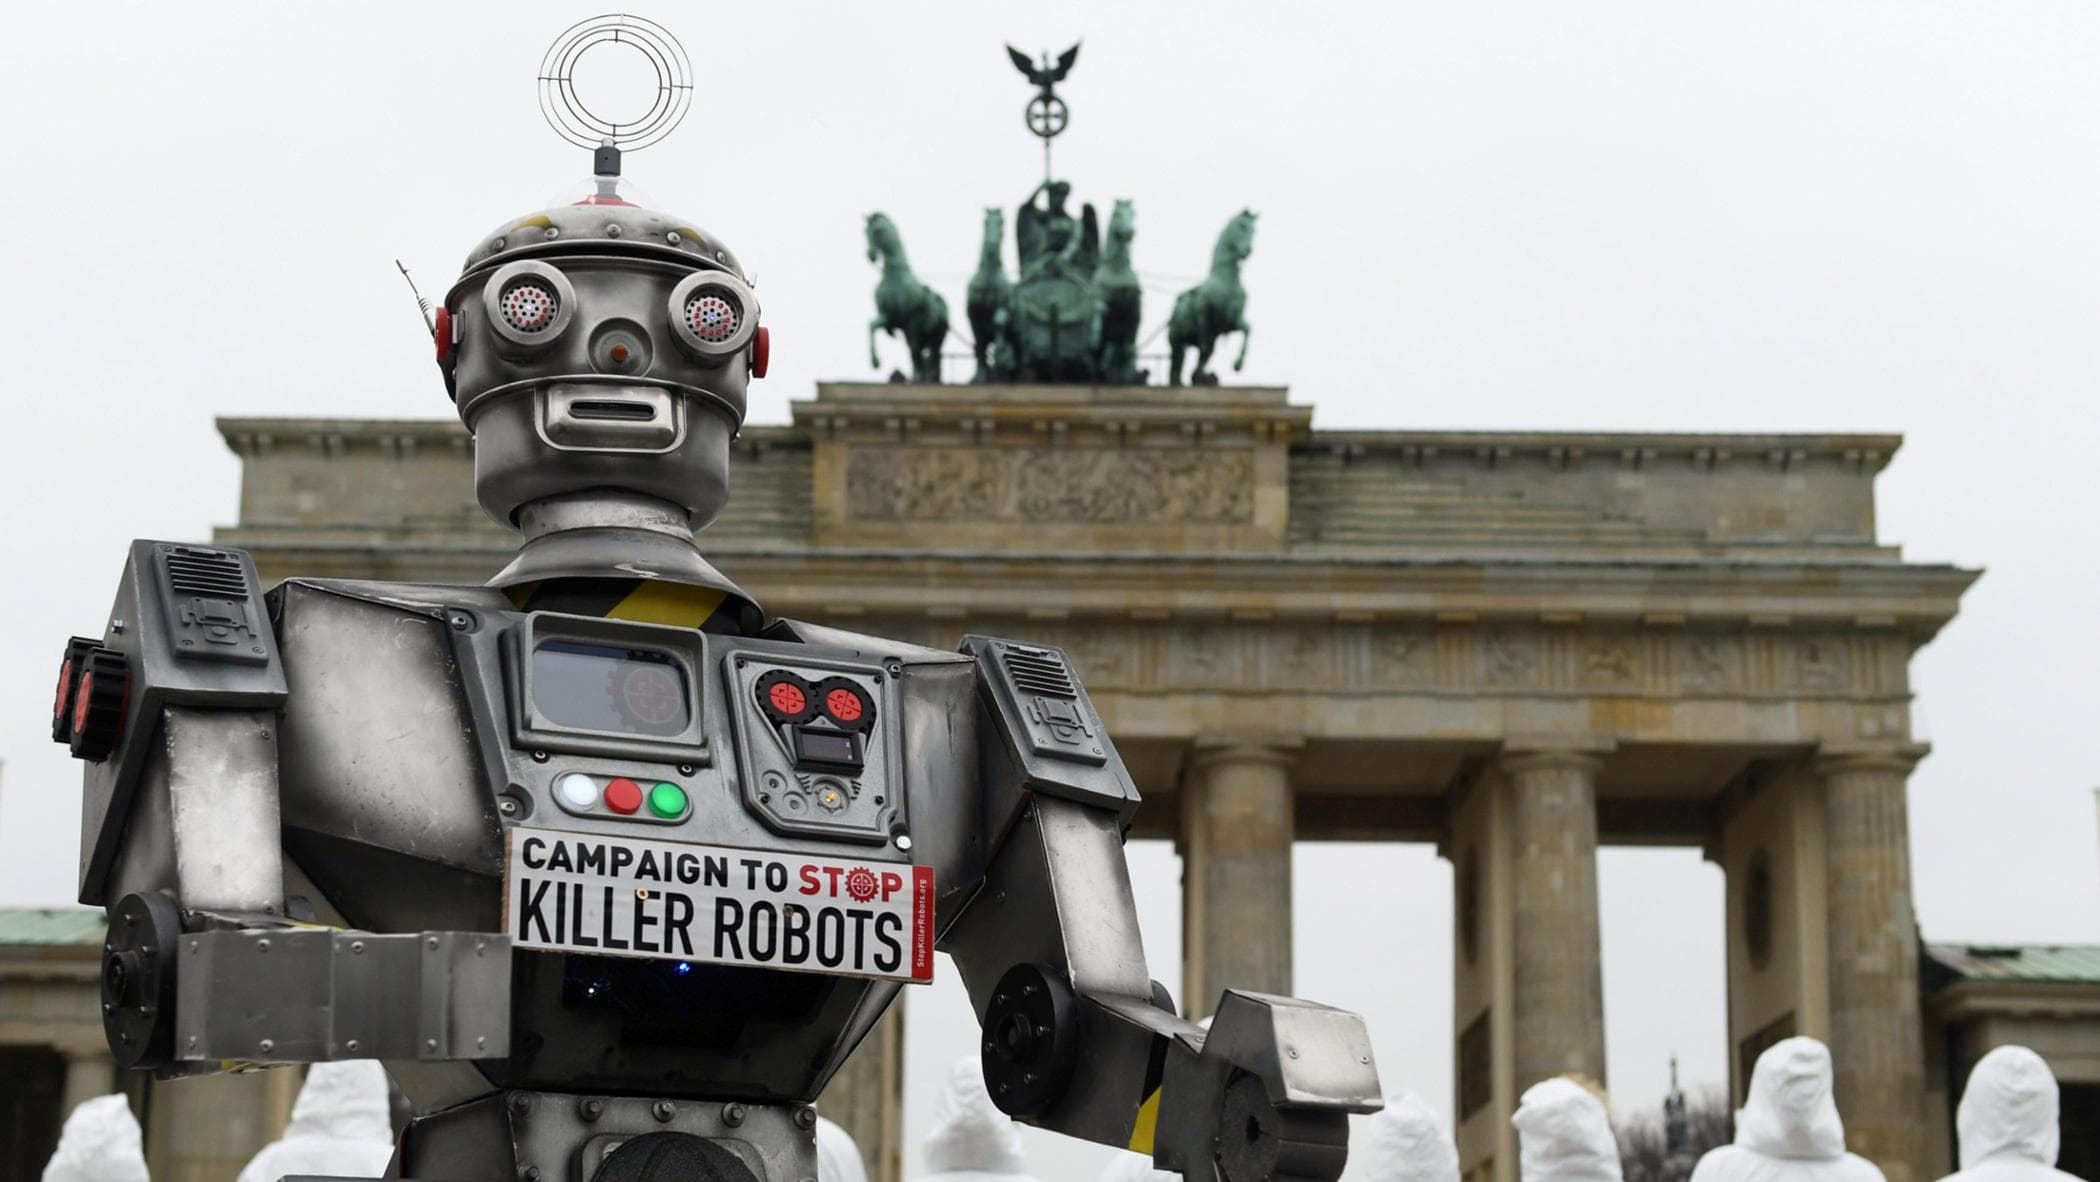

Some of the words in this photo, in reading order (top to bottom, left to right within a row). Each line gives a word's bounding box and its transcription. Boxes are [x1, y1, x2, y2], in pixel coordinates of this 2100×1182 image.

[522, 836, 729, 889] CAMPAIGN
[740, 858, 789, 893] TO
[798, 864, 903, 904] STOP
[518, 877, 695, 956] KILLER
[713, 896, 903, 973] ROBOTS
[917, 879, 928, 968] StopKillerRobots.org
